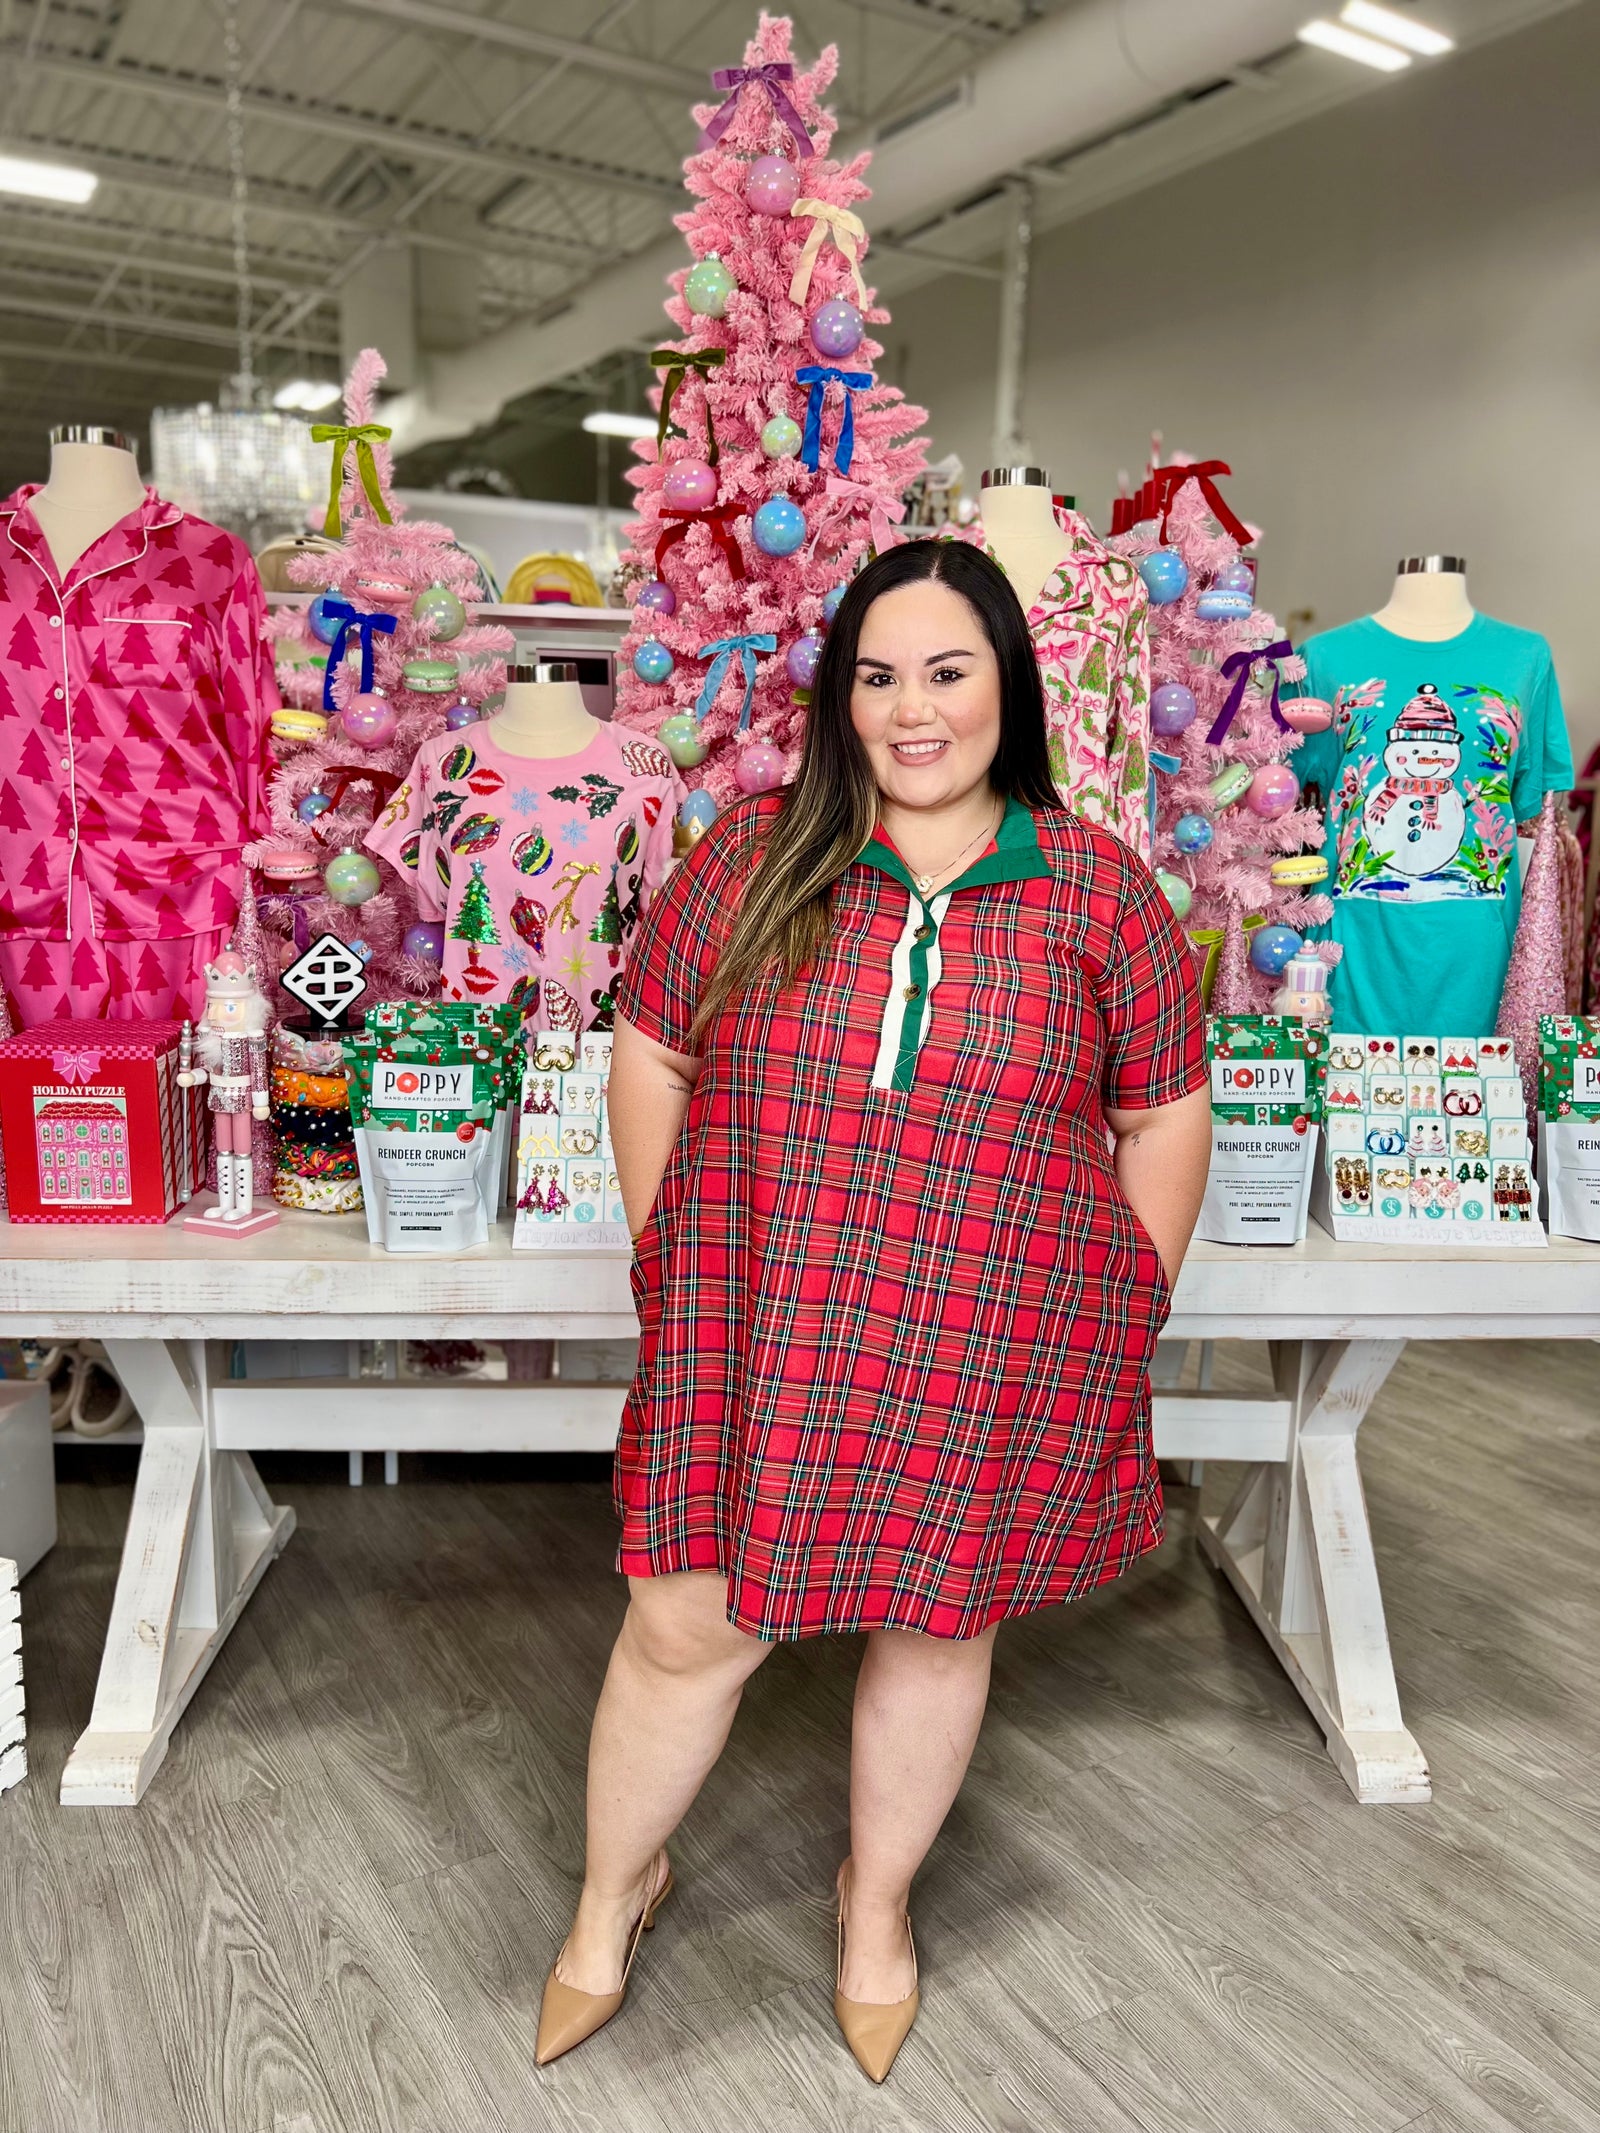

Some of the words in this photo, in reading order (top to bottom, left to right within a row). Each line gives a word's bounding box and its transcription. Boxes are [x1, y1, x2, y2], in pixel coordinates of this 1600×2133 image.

[385, 1071, 462, 1095] POPPY
[1223, 1067, 1294, 1089] POPPY
[32, 1085, 84, 1096] HOLIDAY
[85, 1086, 126, 1096] PUZZLE
[378, 1148, 422, 1160] REINDEER
[425, 1148, 467, 1161] CRUNCH
[1217, 1141, 1262, 1152] REINDEER
[1265, 1142, 1300, 1152] CRUNCH
[518, 1228, 582, 1248] Taylor
